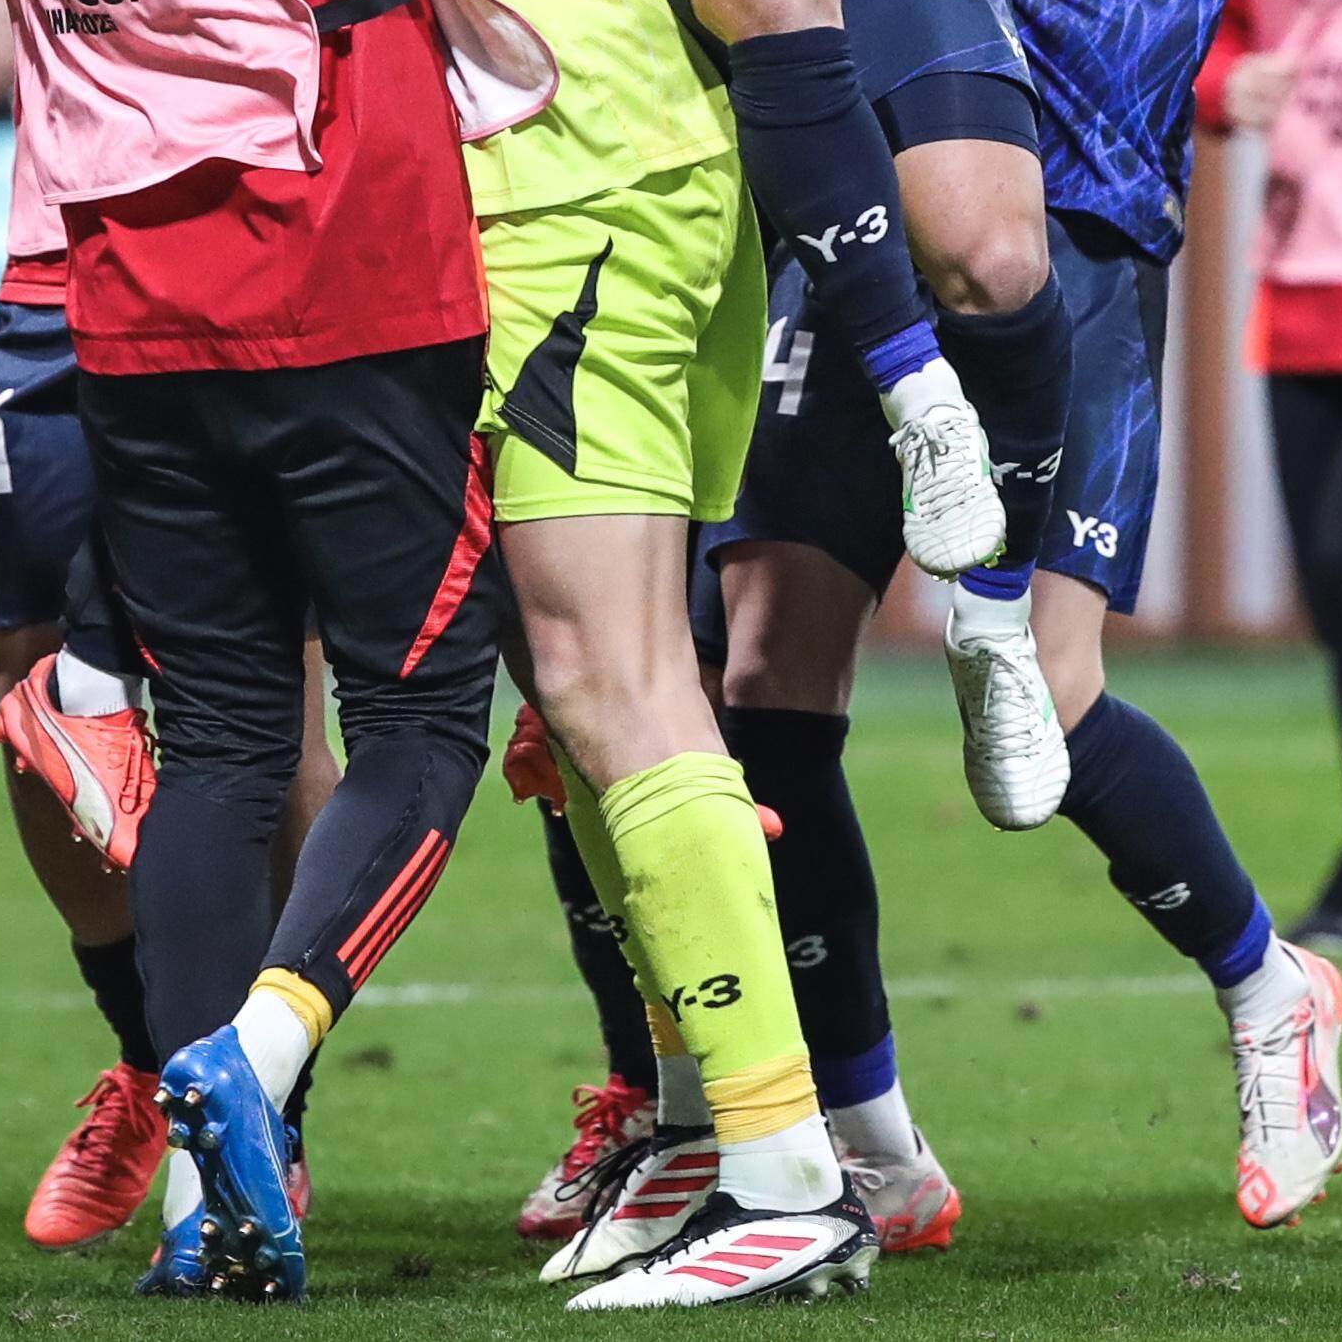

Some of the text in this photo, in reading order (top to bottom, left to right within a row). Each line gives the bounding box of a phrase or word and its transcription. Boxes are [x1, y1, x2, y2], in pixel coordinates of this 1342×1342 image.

[795, 205, 889, 263] Y-3
[988, 446, 1064, 486] Y-3
[1066, 509, 1119, 559] Y-3
[660, 973, 743, 1024] Y-3
